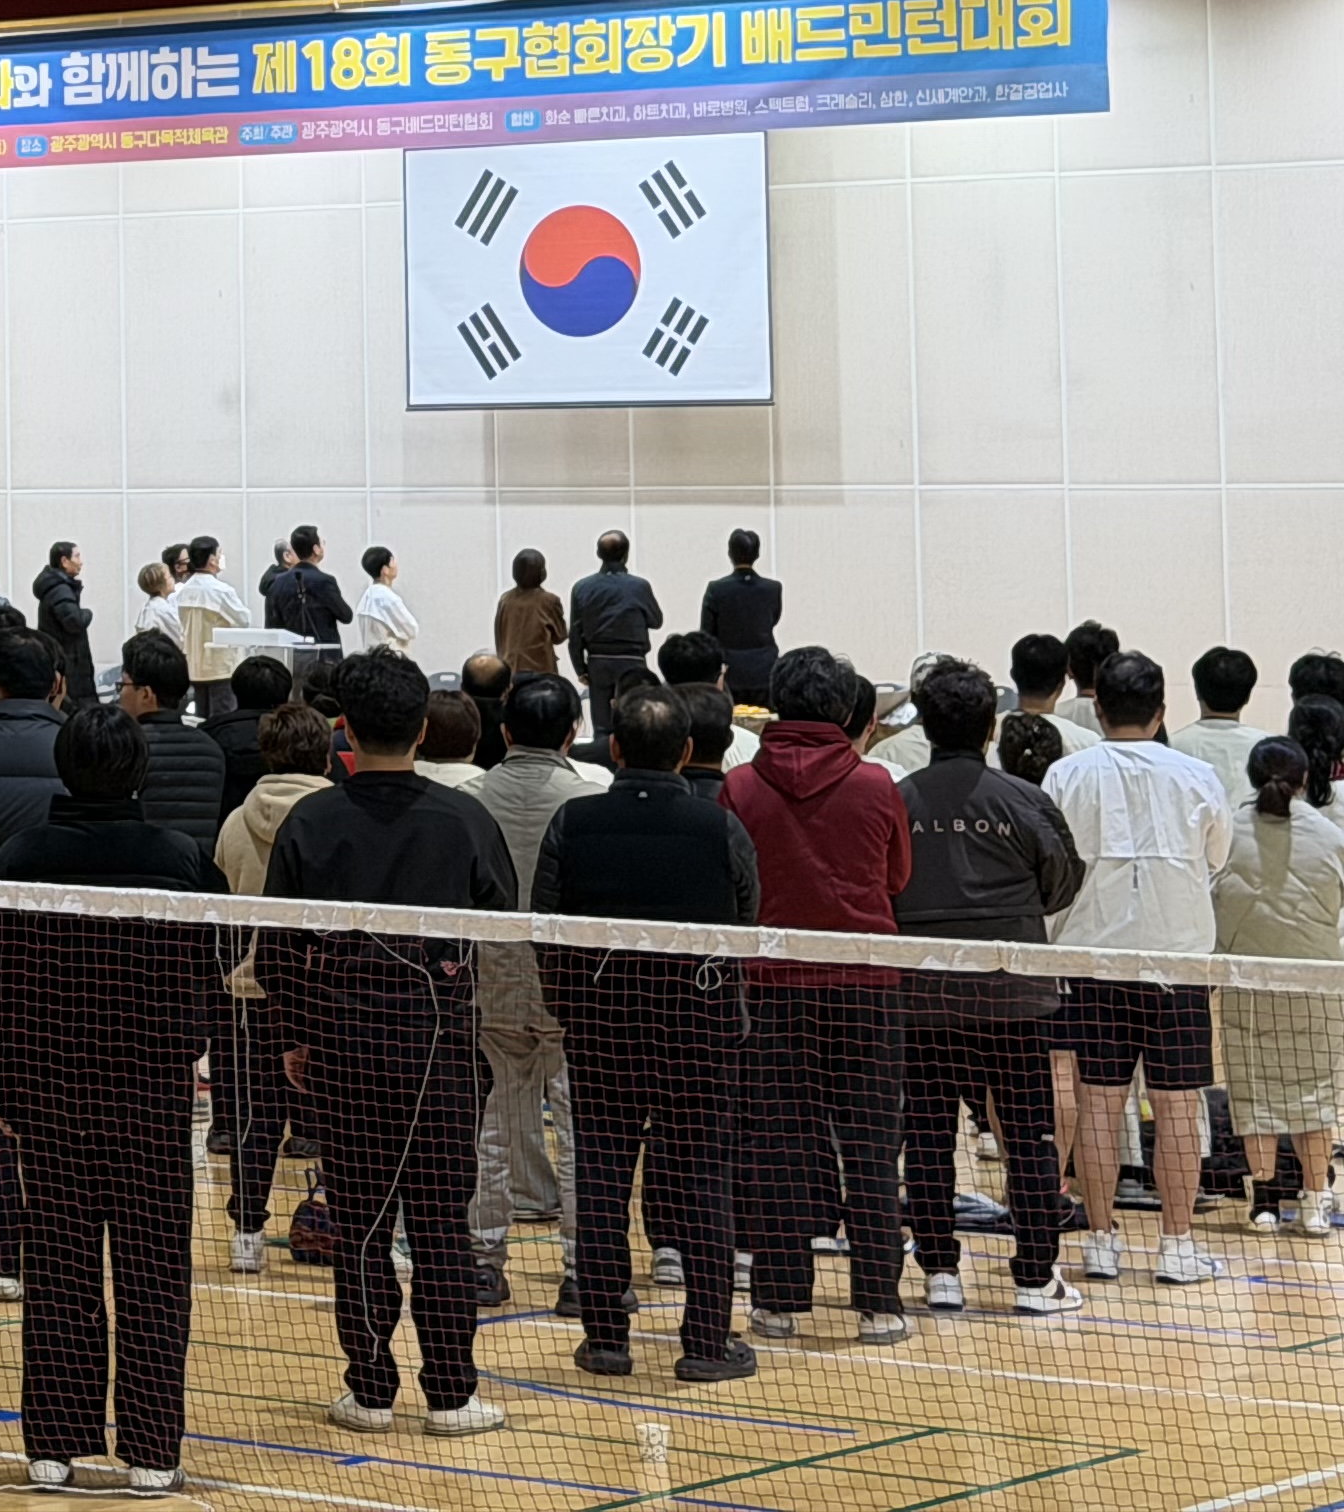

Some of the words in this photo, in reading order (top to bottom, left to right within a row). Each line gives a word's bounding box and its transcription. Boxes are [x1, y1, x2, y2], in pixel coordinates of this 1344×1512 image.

[61, 45, 240, 106] 함께하는
[252, 32, 411, 94] 제18회
[424, 11, 727, 86] 동구협회장기
[301, 119, 373, 140] 광주광역시
[376, 111, 494, 136] 동구배드민턴협회
[544, 109, 571, 125] 화순
[21, 139, 42, 153] 장소
[50, 131, 117, 153] 광주광역시
[120, 126, 229, 150] 동구다목적체육관
[911, 818, 1012, 837] ALBON
